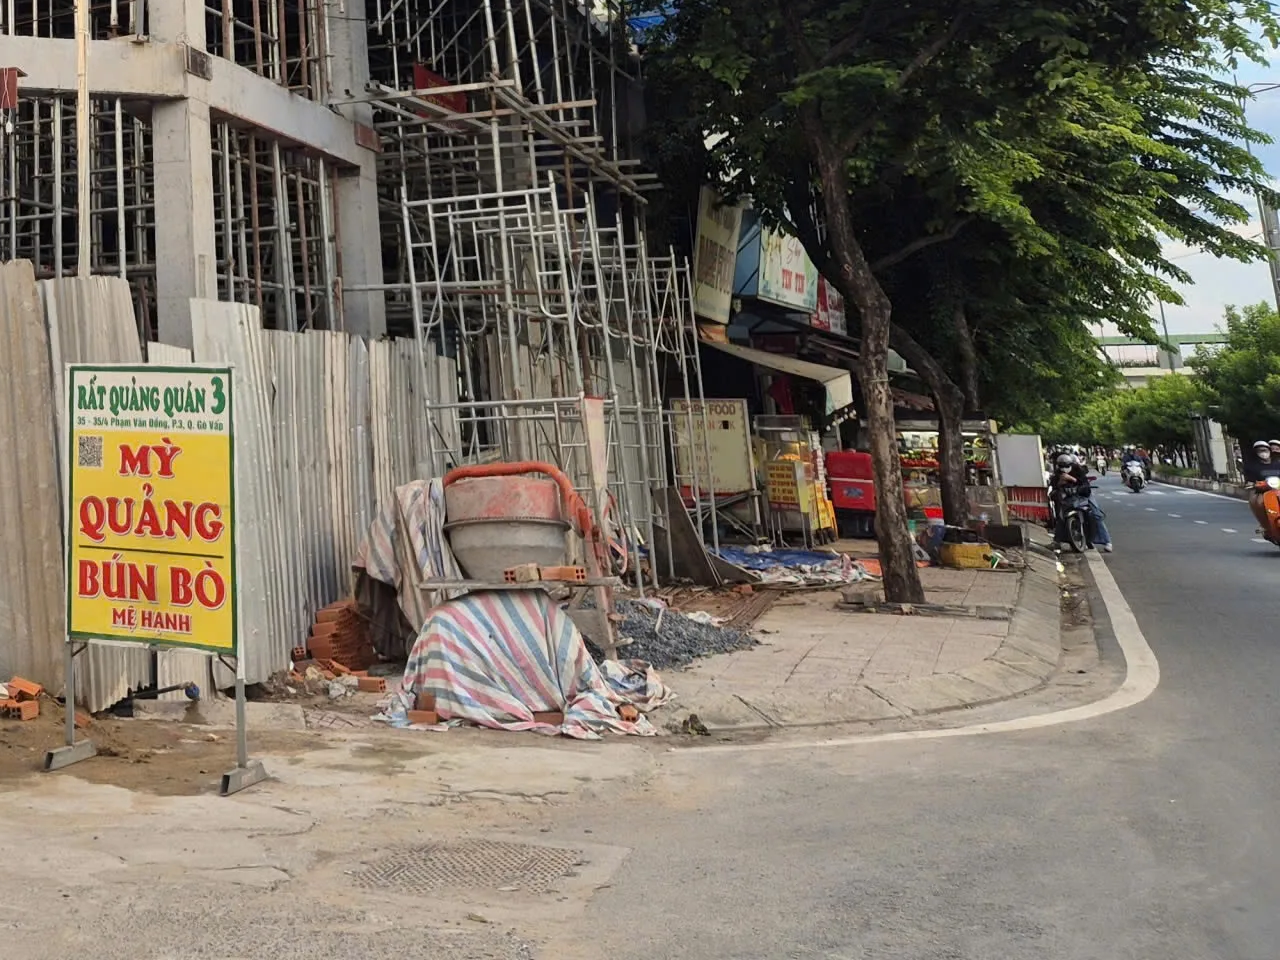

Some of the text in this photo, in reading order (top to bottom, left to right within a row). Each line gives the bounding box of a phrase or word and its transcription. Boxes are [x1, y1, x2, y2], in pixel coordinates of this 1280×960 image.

[163, 380, 206, 418] QUÁN
[211, 376, 226, 415] 3
[709, 402, 736, 416] FOOD
[77, 416, 86, 426] 35
[93, 416, 108, 427] 35/4
[119, 437, 182, 478] MỲ
[80, 483, 225, 542] QUẢNG
[78, 553, 226, 610] BÚN BÒ
[112, 605, 191, 633] MỆ HẠNH
